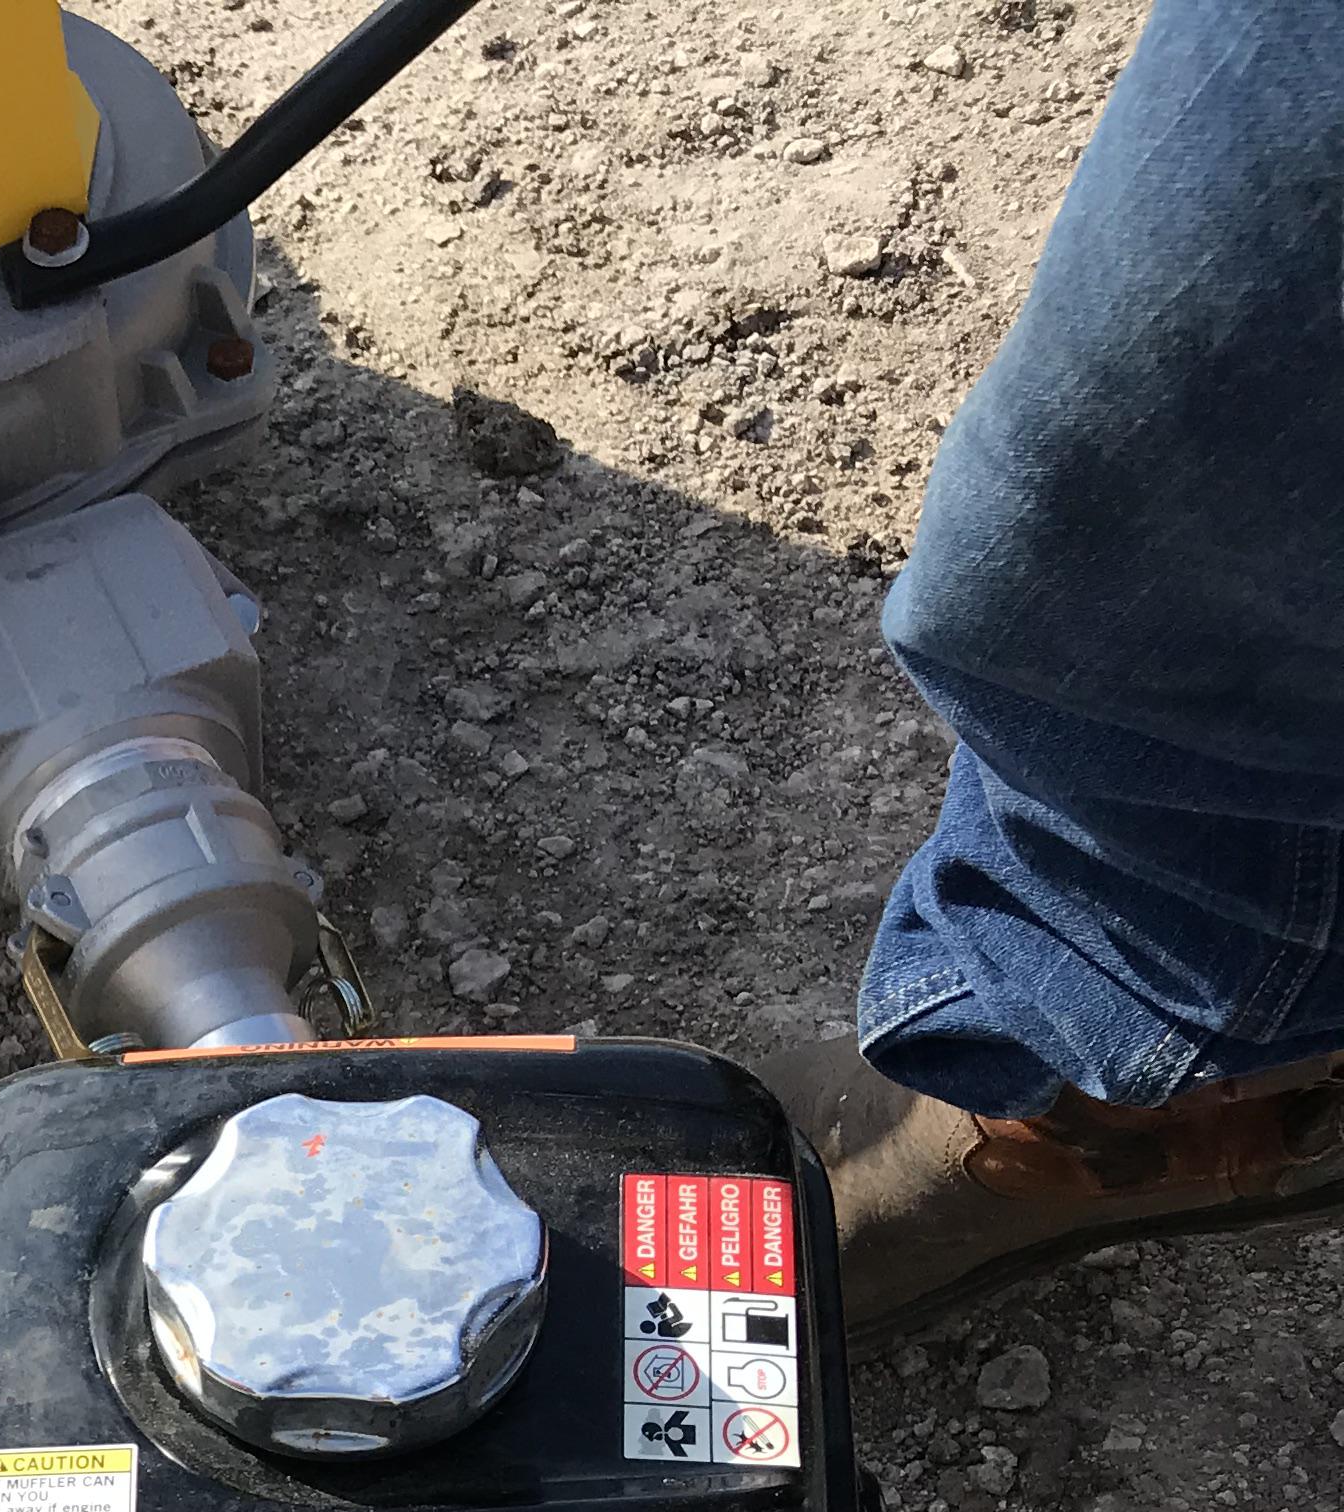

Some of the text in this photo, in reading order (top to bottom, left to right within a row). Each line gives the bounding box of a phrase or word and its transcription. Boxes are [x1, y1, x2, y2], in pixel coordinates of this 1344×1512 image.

[240, 1039, 396, 1052] WARNING
[637, 1179, 655, 1258] DANGER
[679, 1184, 697, 1261] GEFAHR
[721, 1183, 740, 1267] PELIGRO
[764, 1187, 782, 1266] DANGER
[757, 1369, 767, 1390] STOP
[13, 1455, 105, 1472] CAUTION
[7, 1477, 76, 1490] MUFFLER
[83, 1476, 115, 1487] CAN
[18, 1491, 49, 1502] YOU
[48, 1503, 56, 1512] if
